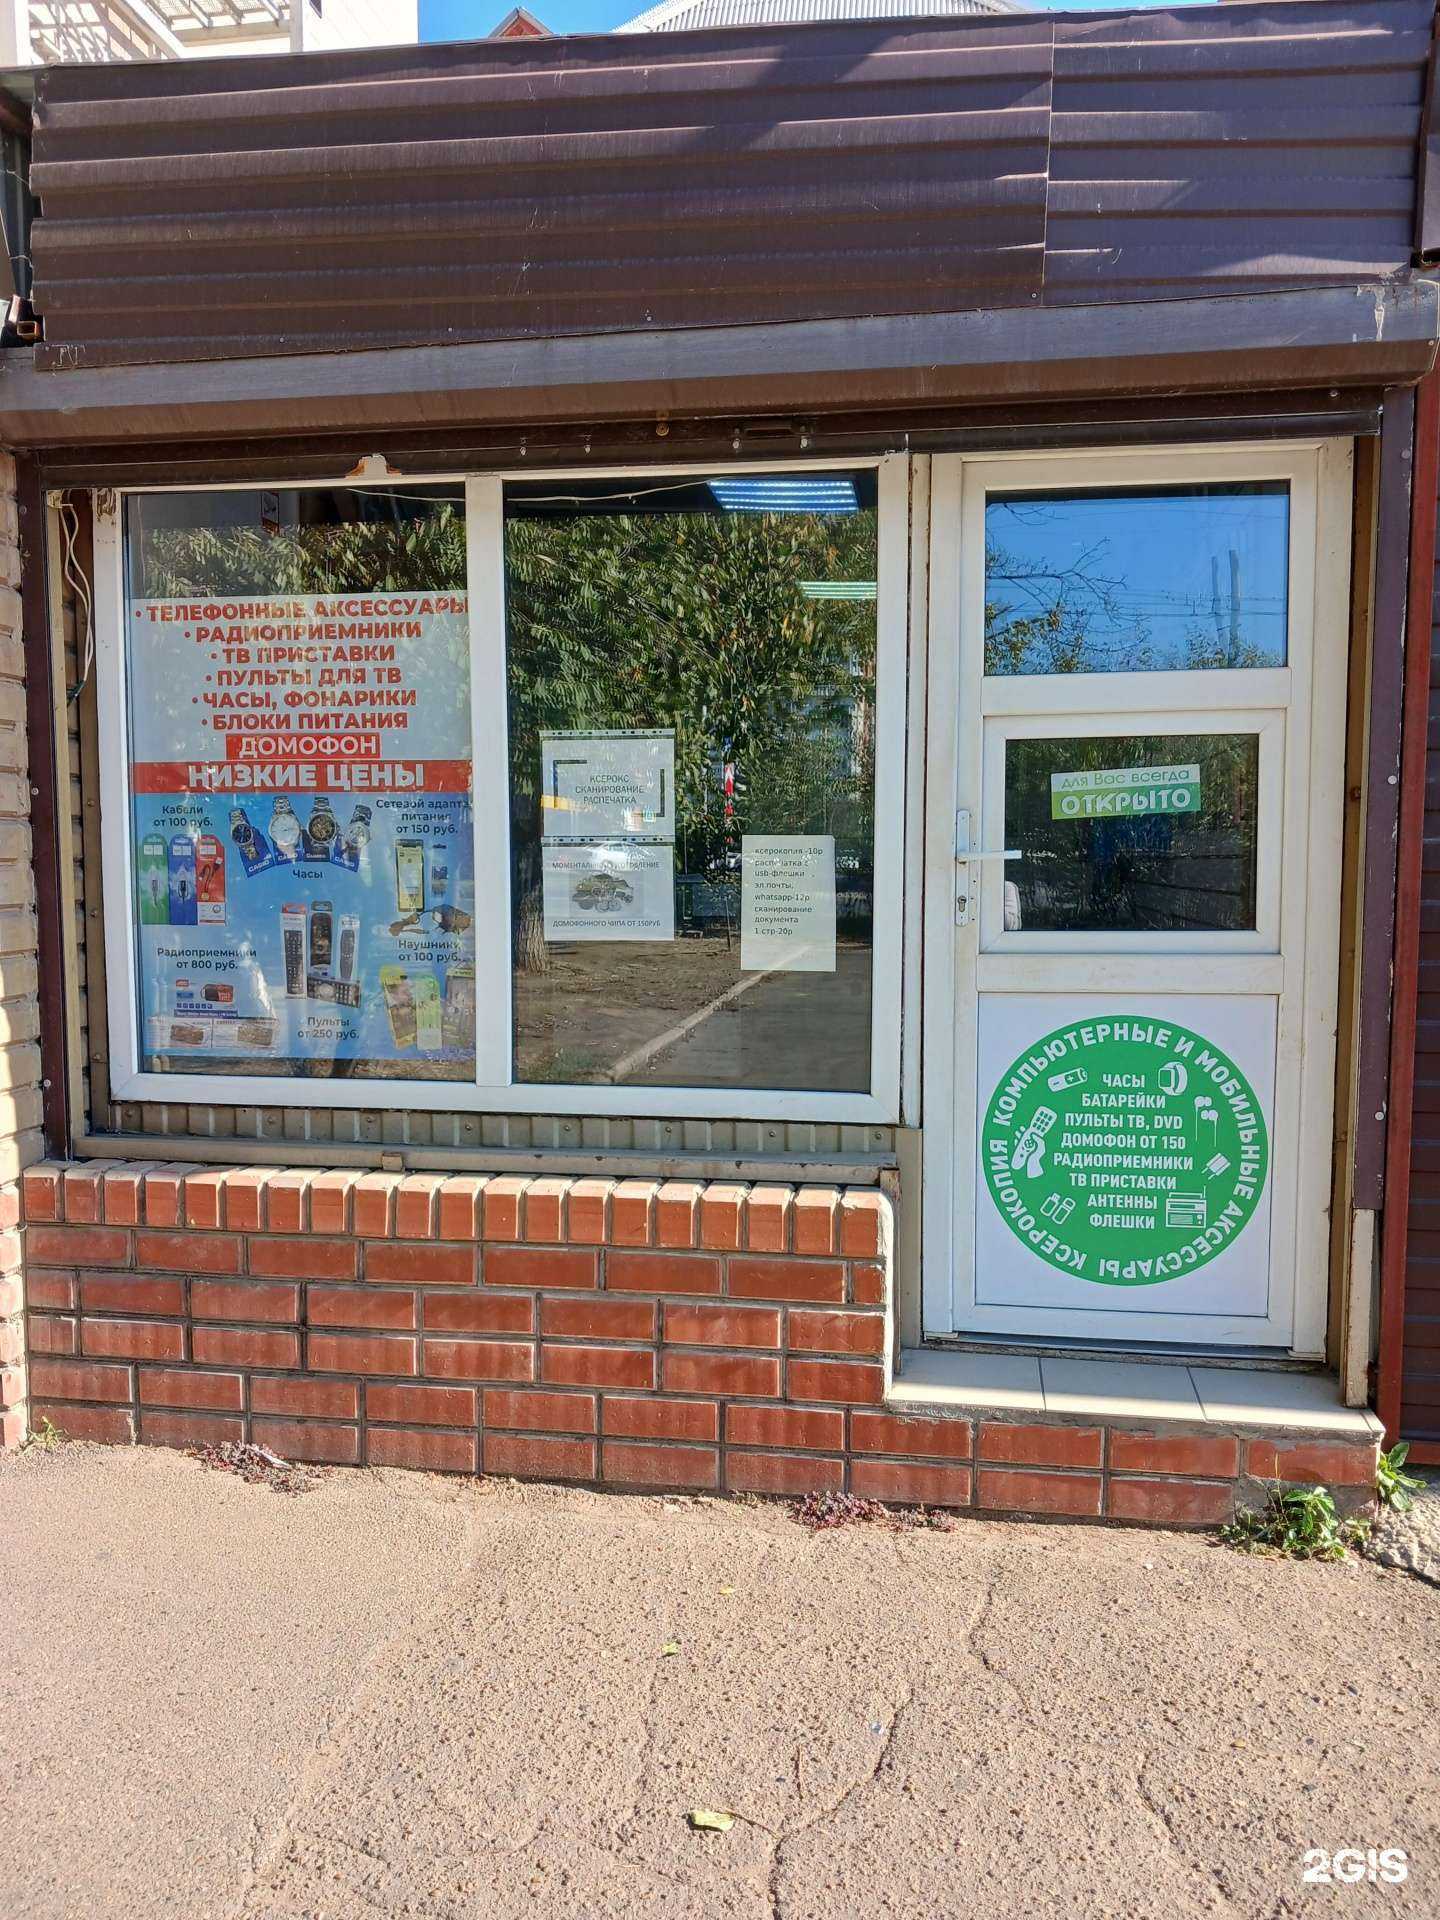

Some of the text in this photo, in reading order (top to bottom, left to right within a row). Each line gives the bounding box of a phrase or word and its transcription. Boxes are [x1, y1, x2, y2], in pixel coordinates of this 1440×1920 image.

[146, 597, 469, 622] ТЕЛЕФОННЫЕ АКСЕССУАРЫ
[195, 622, 422, 645] РАДИОПРИЕМНИКИ
[223, 645, 395, 664] ТВ ПРИСТАВКИ
[217, 667, 402, 687] ПУЛЬТЫ ДЛЯ ТВ
[203, 689, 416, 711] ЧАСЫ, ФОНАРИКИ
[213, 712, 408, 730] БЛОКИ ПИТАНИЯ
[239, 735, 377, 758] ДОМОФОН
[188, 763, 424, 790] НИЗКИЕ ЦЕНЫ
[590, 775, 630, 783] КСЕРОКС
[1094, 773, 1126, 786] Вас
[1131, 768, 1190, 784] всегда
[575, 785, 645, 794] СКАНИРОВАНИЕ
[583, 796, 637, 804] РАСПЕЧАТКА
[1061, 788, 1191, 816] ОТКРЫТО
[162, 805, 204, 815] Кабели
[153, 817, 213, 828] от 100 руб.
[412, 824, 430, 833] 150
[433, 823, 458, 835] руб.
[293, 870, 323, 879] Часы
[754, 915, 799, 924] документа
[157, 947, 257, 958] Радиоприемники
[398, 940, 460, 951] Наушники
[191, 960, 212, 969] 800
[215, 960, 238, 971] руб.
[398, 952, 461, 964] от 100 руб.
[308, 1016, 350, 1027] Пульты
[298, 1029, 359, 1040] от 250 руб.
[1102, 1073, 1145, 1088] ЧАСЫ
[1081, 1091, 1166, 1109] БАТАРЕЙКИ
[1065, 1112, 1183, 1131] ПУЛЬТЫ ТВ, DVD
[1061, 1132, 1186, 1150] ДОМОФОН ОТ 150
[992, 1022, 1262, 1279] КОМПЬЮТЕРНЫЕ И МОБИЛЬНЫЕ АКСЕССУАРЫ
[1053, 1152, 1193, 1170] РАДИОПРИЕМНИКИ
[1069, 1173, 1177, 1190] ТВ ПРИСТАВКИ
[989, 1138, 1088, 1271] КСЕРОКОПИЯ
[1087, 1194, 1158, 1210] АНТЕННЫ
[1089, 1214, 1155, 1230] ФЛЕШКИ
